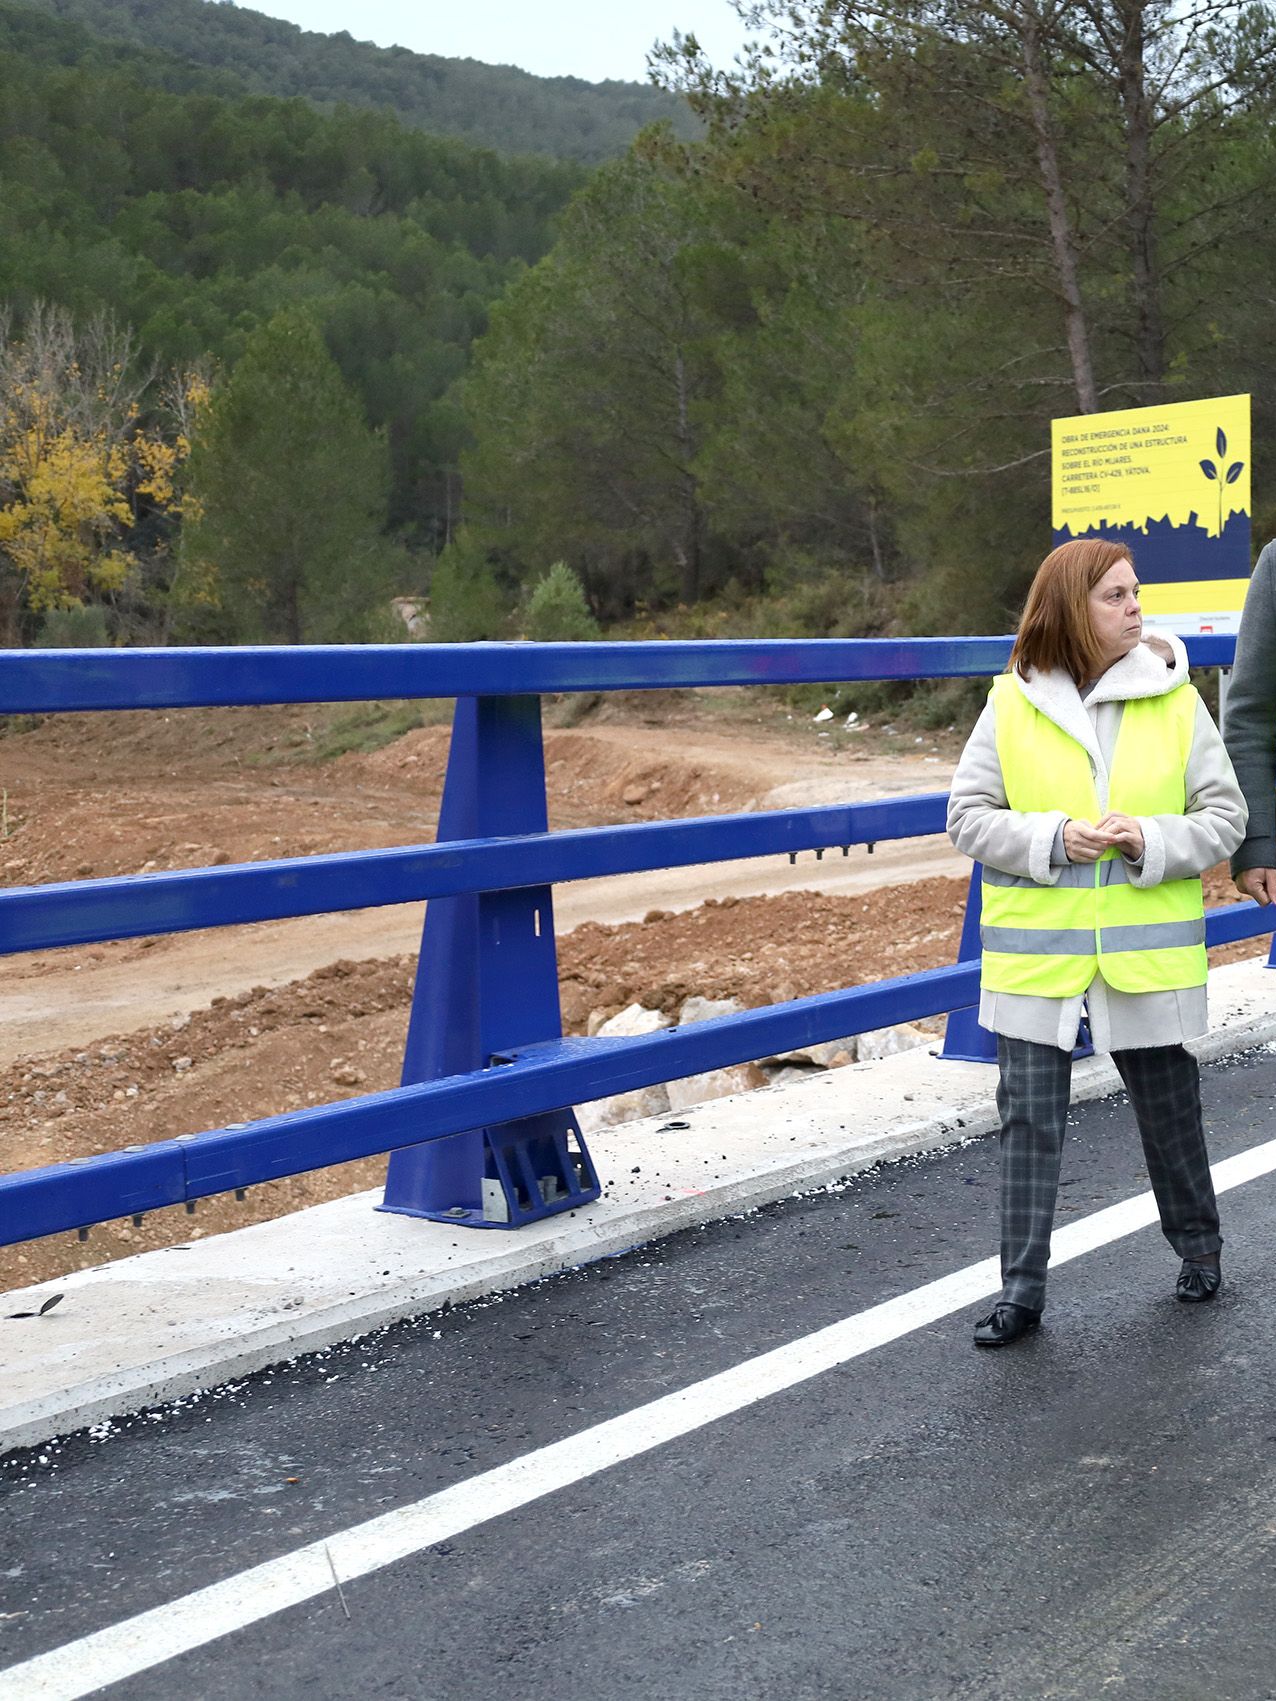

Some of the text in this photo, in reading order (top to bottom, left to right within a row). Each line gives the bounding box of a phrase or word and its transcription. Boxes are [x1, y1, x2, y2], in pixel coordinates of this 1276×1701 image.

[1061, 434, 1079, 444] OBRA
[1080, 433, 1089, 442] DE
[1090, 428, 1131, 441] EMERGENCIA
[1132, 426, 1151, 436] DANA
[1119, 441, 1128, 451] DE
[1129, 440, 1143, 450] UNA
[1145, 435, 1188, 448] ESTRUCTURA
[1061, 461, 1082, 471] SOBRE
[1083, 459, 1091, 468] EL
[1061, 471, 1099, 483] CARRETERA
